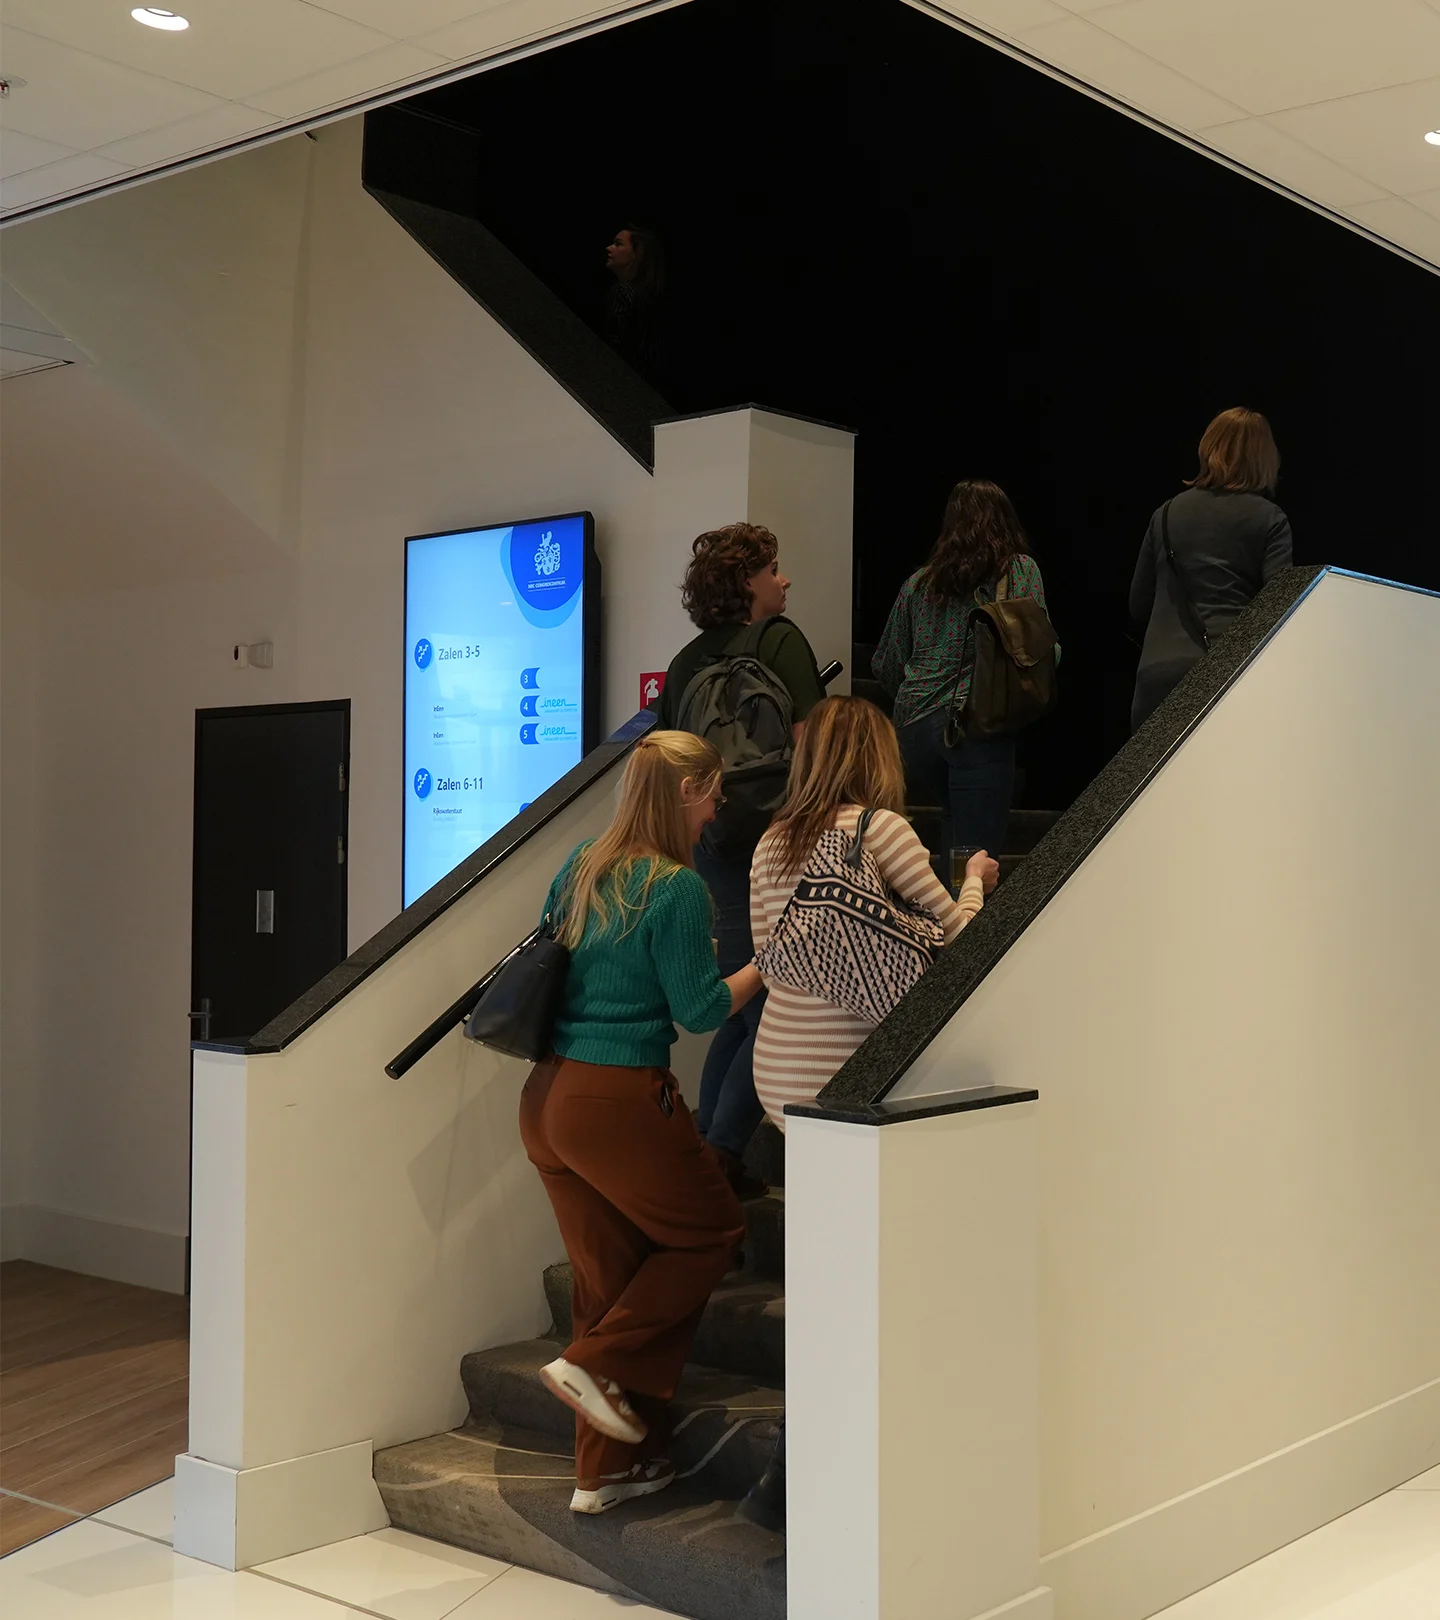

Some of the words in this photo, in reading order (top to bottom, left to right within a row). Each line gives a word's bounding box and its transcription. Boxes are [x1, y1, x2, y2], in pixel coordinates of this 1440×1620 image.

[438, 647, 463, 661] Zalen
[465, 645, 480, 659] 3-5
[523, 674, 529, 684] 3
[523, 702, 529, 711] 4
[523, 729, 528, 739] 5
[437, 777, 461, 791] Zalen
[463, 776, 483, 790] 6-11
